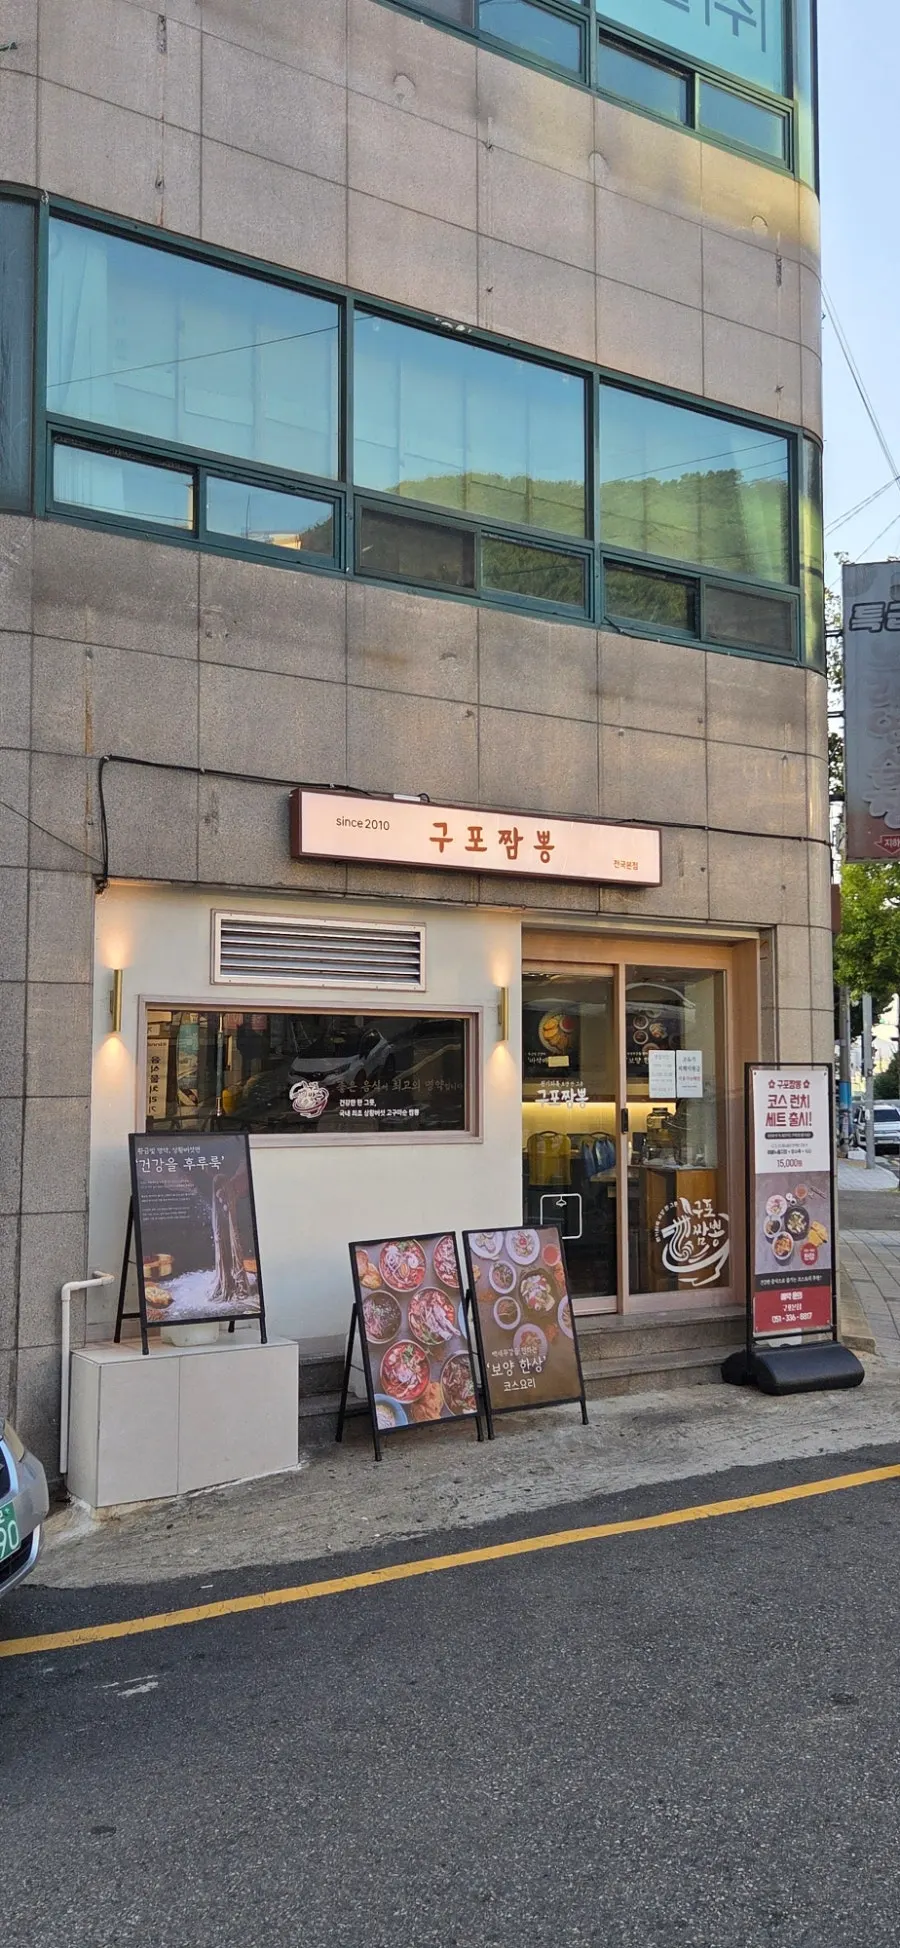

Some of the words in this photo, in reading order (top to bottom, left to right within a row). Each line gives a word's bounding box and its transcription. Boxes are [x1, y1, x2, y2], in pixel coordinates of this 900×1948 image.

[335, 815, 363, 830] since
[364, 817, 390, 831] 2010
[429, 822, 555, 864] 구포짬뽕
[777, 1080, 801, 1089] 구포짬뽕
[768, 1095, 787, 1109] 코스
[790, 1095, 810, 1108] 런치
[765, 1112, 787, 1126] 세트
[788, 1112, 812, 1126] 출시!
[692, 1198, 716, 1218] 구포
[693, 1219, 725, 1247] 짬뽕
[504, 1378, 536, 1392] 코스요리
